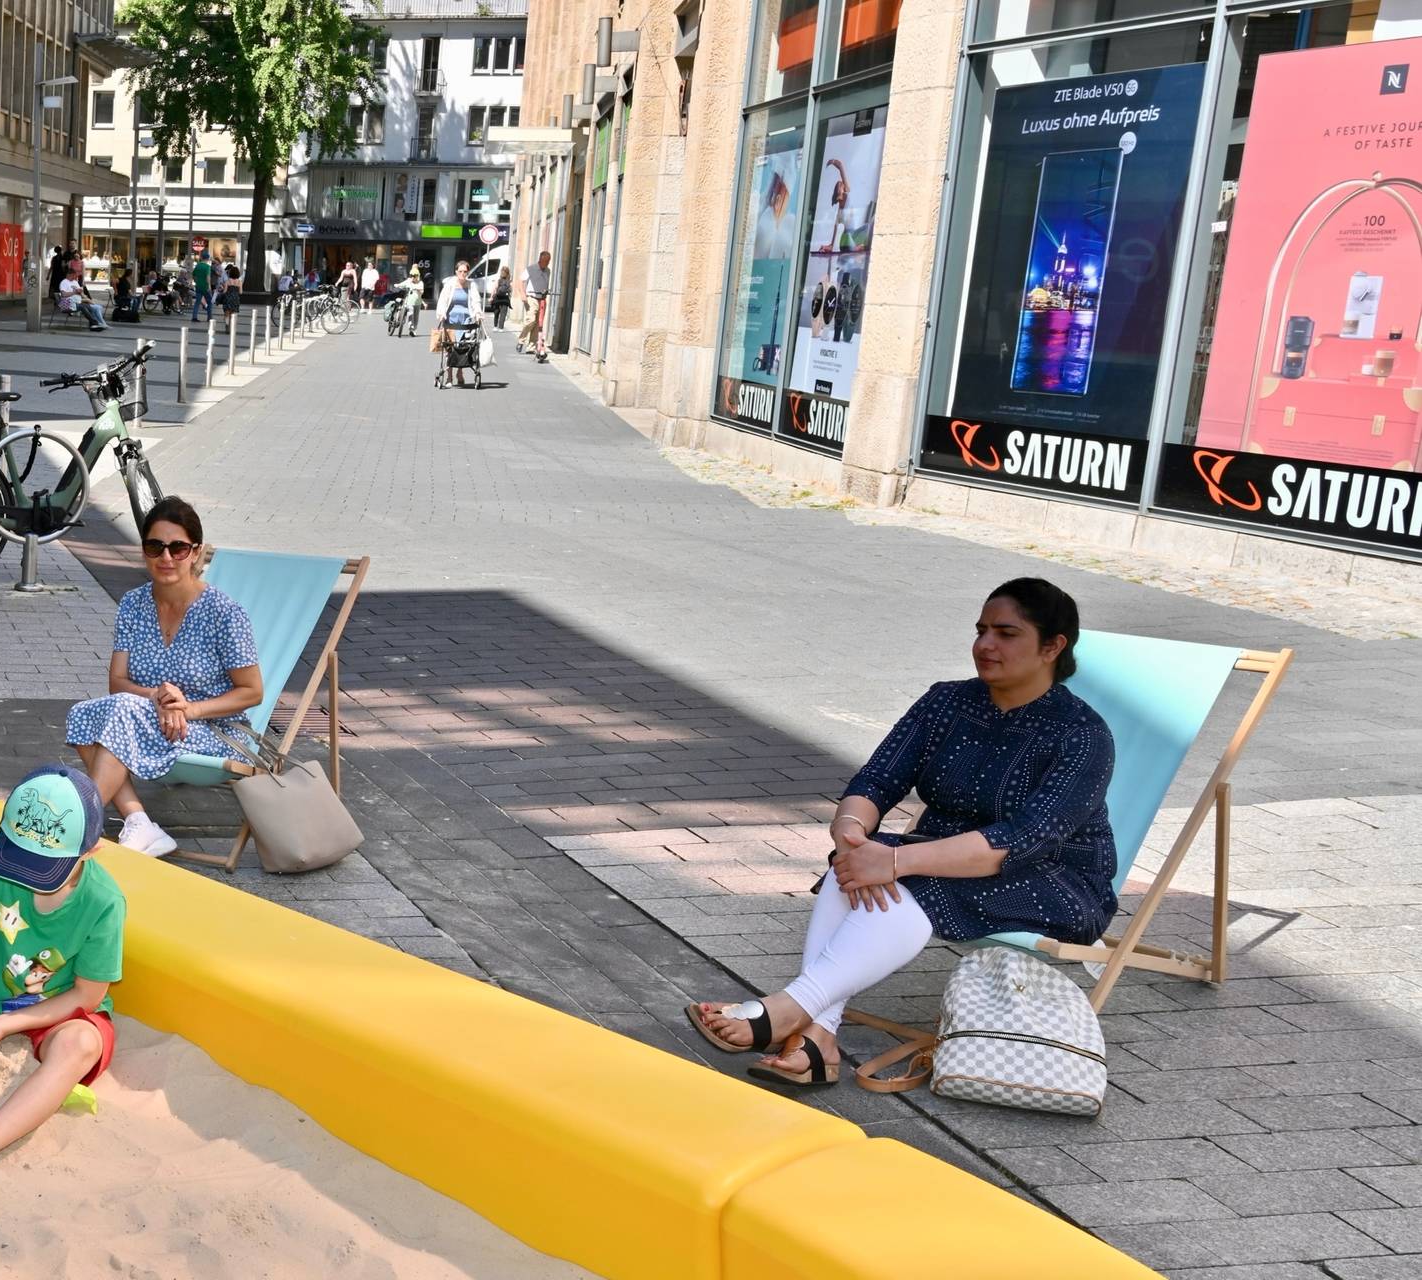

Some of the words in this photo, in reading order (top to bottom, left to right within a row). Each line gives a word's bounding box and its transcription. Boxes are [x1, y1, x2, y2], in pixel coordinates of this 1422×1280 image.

[1054, 89, 1072, 103] ZTE
[1073, 85, 1102, 100] Blade
[1103, 82, 1124, 97] V50
[1021, 118, 1061, 134] Luxus
[1063, 112, 1097, 128] ohne
[1098, 104, 1161, 127] Aufpreis
[1323, 129, 1330, 137] A
[1336, 123, 1385, 137] FESTIVE
[1354, 140, 1371, 150] OF
[1376, 138, 1413, 149] TASTE
[101, 194, 168, 209] Krame
[1364, 215, 1386, 226] 100
[3, 228, 19, 257] Sae
[418, 260, 430, 270] 65
[737, 383, 774, 423] SATURN
[1004, 430, 1132, 491] SATURN
